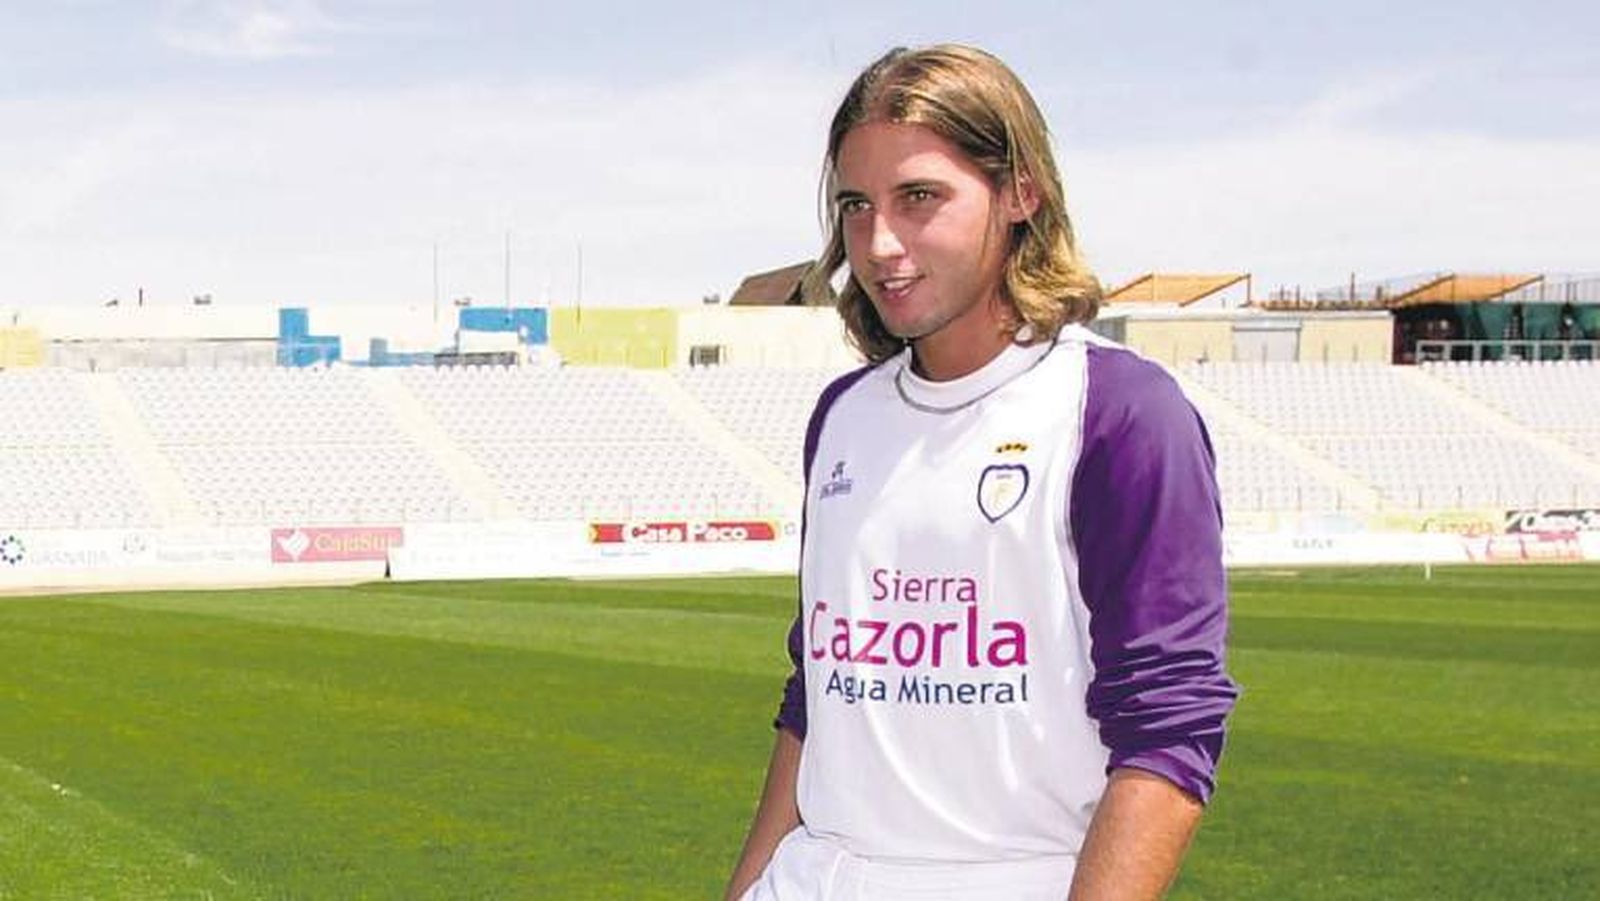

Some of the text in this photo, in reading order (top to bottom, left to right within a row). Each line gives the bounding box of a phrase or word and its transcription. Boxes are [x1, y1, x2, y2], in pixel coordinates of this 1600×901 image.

[872, 568, 977, 602] Sierra
[809, 601, 1028, 668] Cazorla
[825, 669, 1028, 704] Agua Mineral
